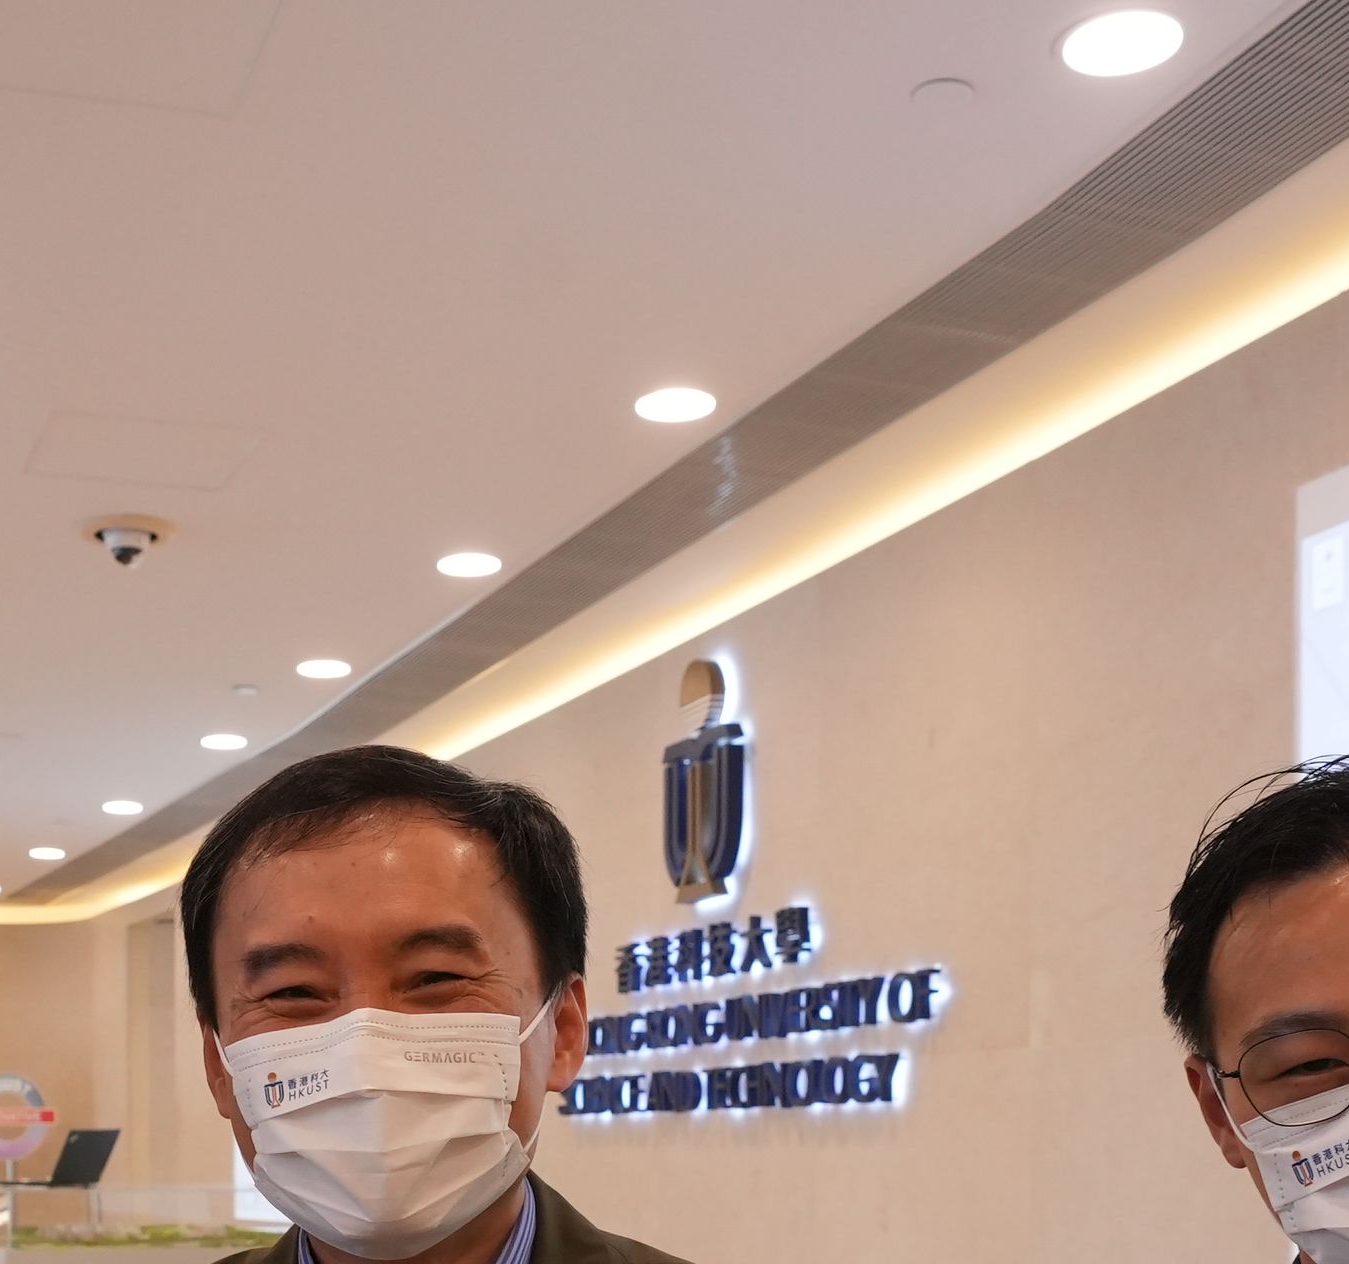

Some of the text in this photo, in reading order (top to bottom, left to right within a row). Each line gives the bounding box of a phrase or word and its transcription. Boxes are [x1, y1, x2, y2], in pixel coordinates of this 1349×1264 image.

[587, 1014, 647, 1055] ONG
[725, 976, 885, 1040] UNIVERSITY
[888, 968, 941, 1023] OF
[288, 1069, 329, 1089] 香港科大
[289, 1080, 329, 1101] HKUST
[707, 1053, 899, 1109] TECHNOLOGY
